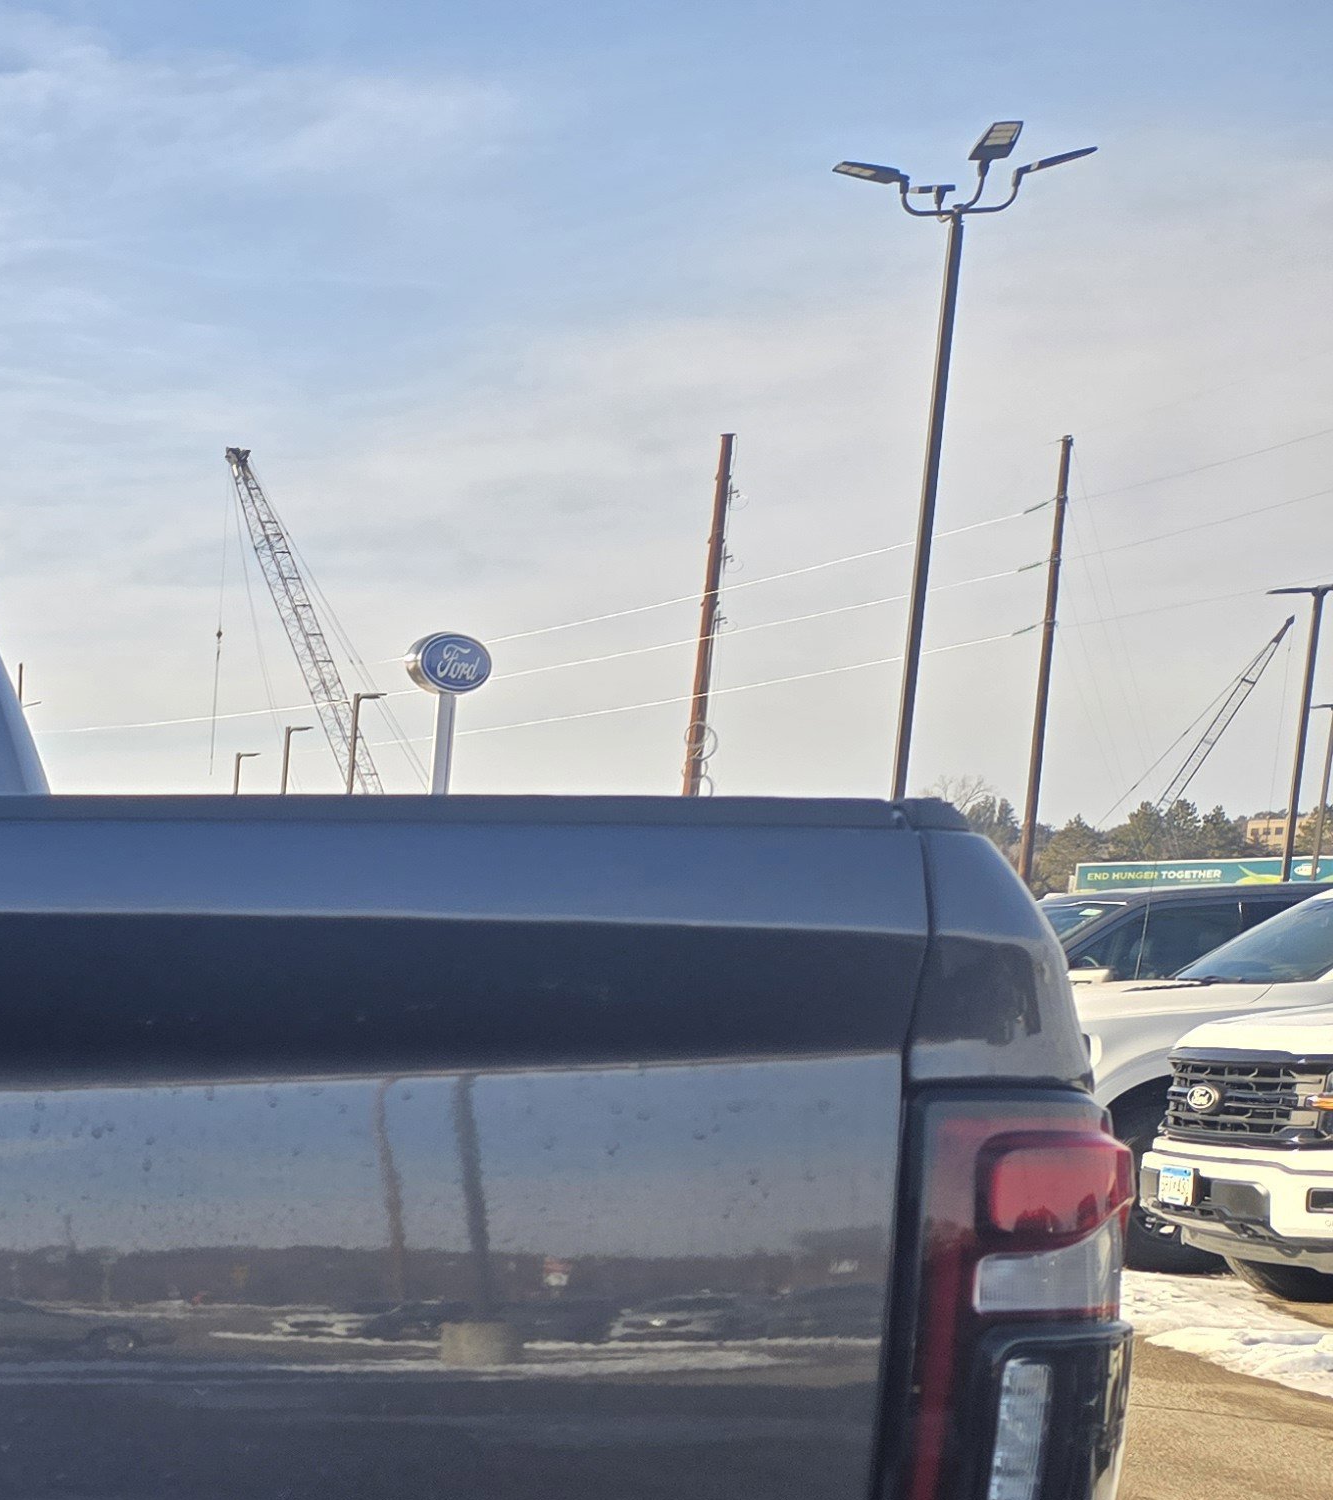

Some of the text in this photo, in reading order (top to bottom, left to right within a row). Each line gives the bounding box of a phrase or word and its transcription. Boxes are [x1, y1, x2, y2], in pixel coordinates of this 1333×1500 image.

[436, 643, 480, 680] Ford
[1087, 869, 1222, 880] END HUNGER TOGETHER
